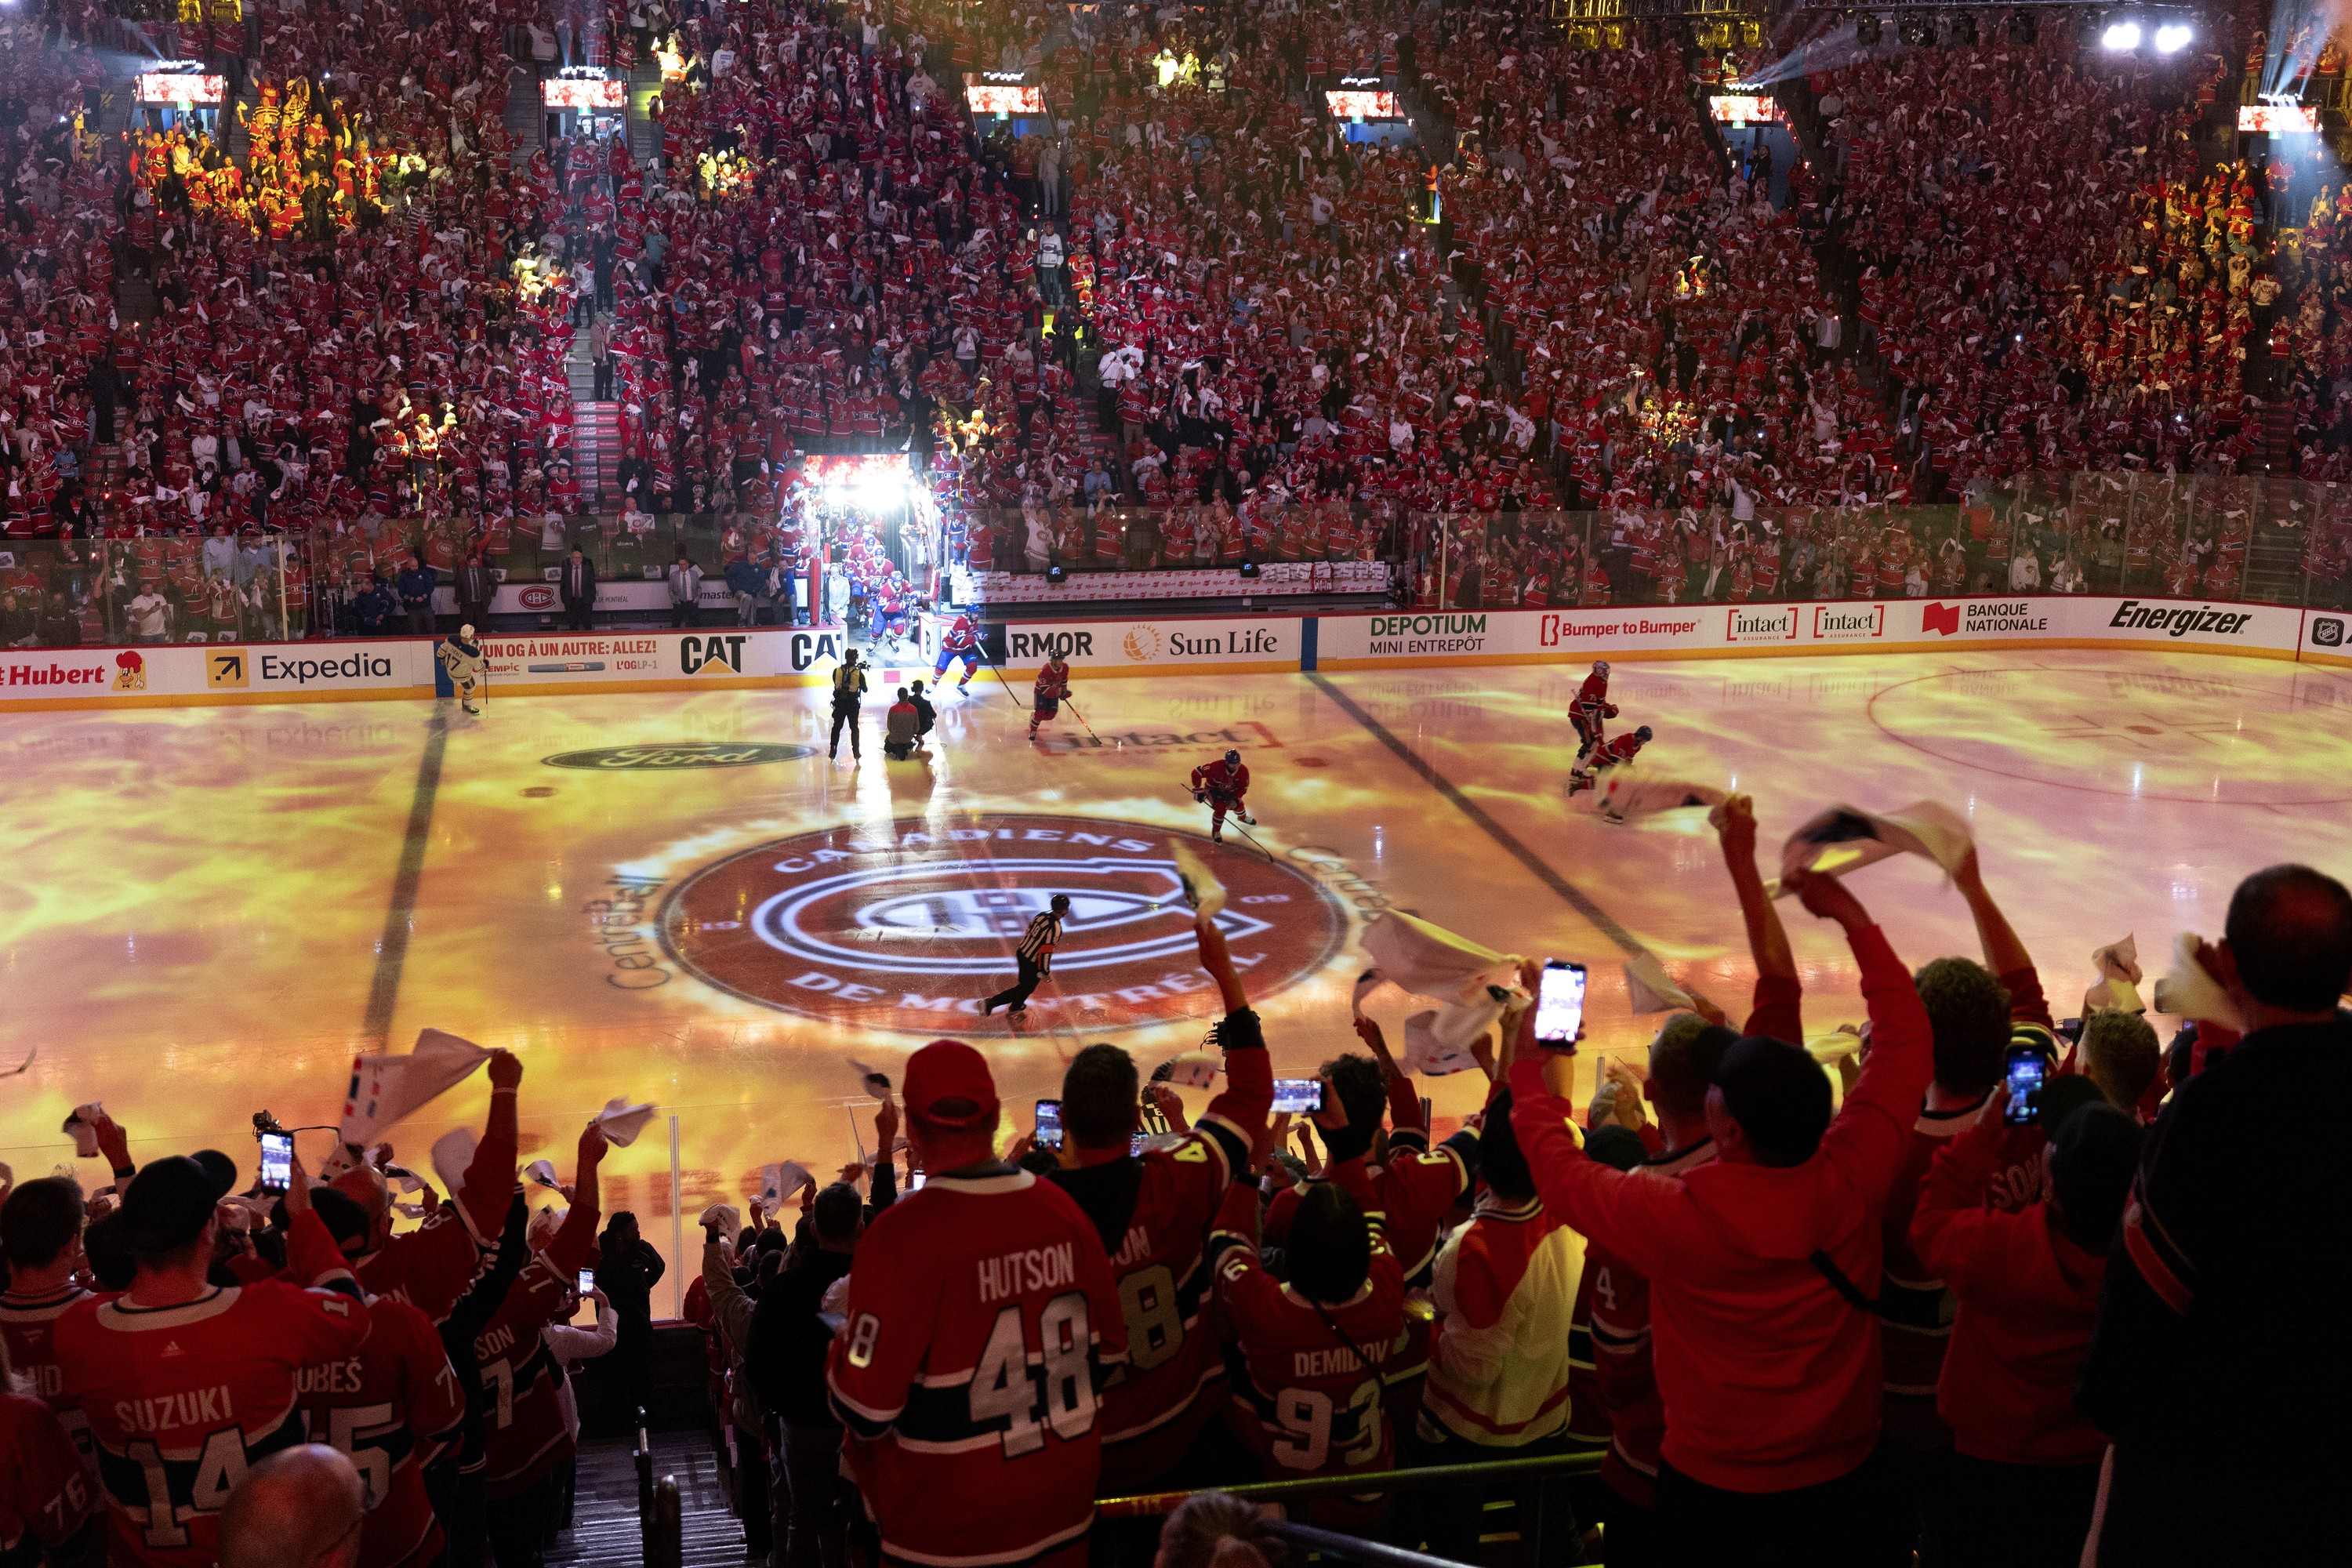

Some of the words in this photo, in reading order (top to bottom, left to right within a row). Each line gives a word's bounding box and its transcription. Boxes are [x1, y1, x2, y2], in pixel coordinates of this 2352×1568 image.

[605, 594, 628, 603] MONTRÉAL
[1966, 603, 2029, 617] BANQUE
[1370, 614, 1486, 636] DEPOTIUM
[1563, 622, 1620, 639] Bumper
[1623, 622, 1637, 635] to
[1639, 620, 1697, 636] Bumper
[1736, 614, 1790, 633] intact
[1823, 612, 1876, 631] intact
[1965, 618, 2048, 633] NATIONALE
[2109, 601, 2253, 637] Energizer
[506, 644, 525, 657] OG
[528, 640, 538, 656] À
[540, 643, 559, 656] UN
[561, 641, 610, 655] AUTRE:
[612, 640, 657, 654] ALLEZ!
[681, 635, 746, 674] CAT
[1006, 631, 1094, 658] RMOR
[1170, 632, 1224, 656] Sun
[1228, 628, 1279, 654] Life
[1370, 641, 1403, 654] MINI
[1408, 635, 1486, 652] ENTREPÔT
[9, 663, 105, 686] Hubert
[262, 653, 391, 684] Expedia
[446, 653, 461, 672] 17
[1059, 728, 1253, 749] intact
[599, 746, 761, 766] Ford
[773, 828, 1156, 873] CANADIENS
[785, 971, 887, 1003] DE
[978, 1241, 1076, 1303] HUTSON
[1109, 1263, 1185, 1380] 8
[844, 1309, 880, 1369] 8
[967, 1290, 1097, 1461] 48
[114, 1385, 234, 1434] SUZUKI
[1271, 1377, 1383, 1472] 93
[301, 1401, 394, 1512] 5
[125, 1424, 249, 1549] 14
